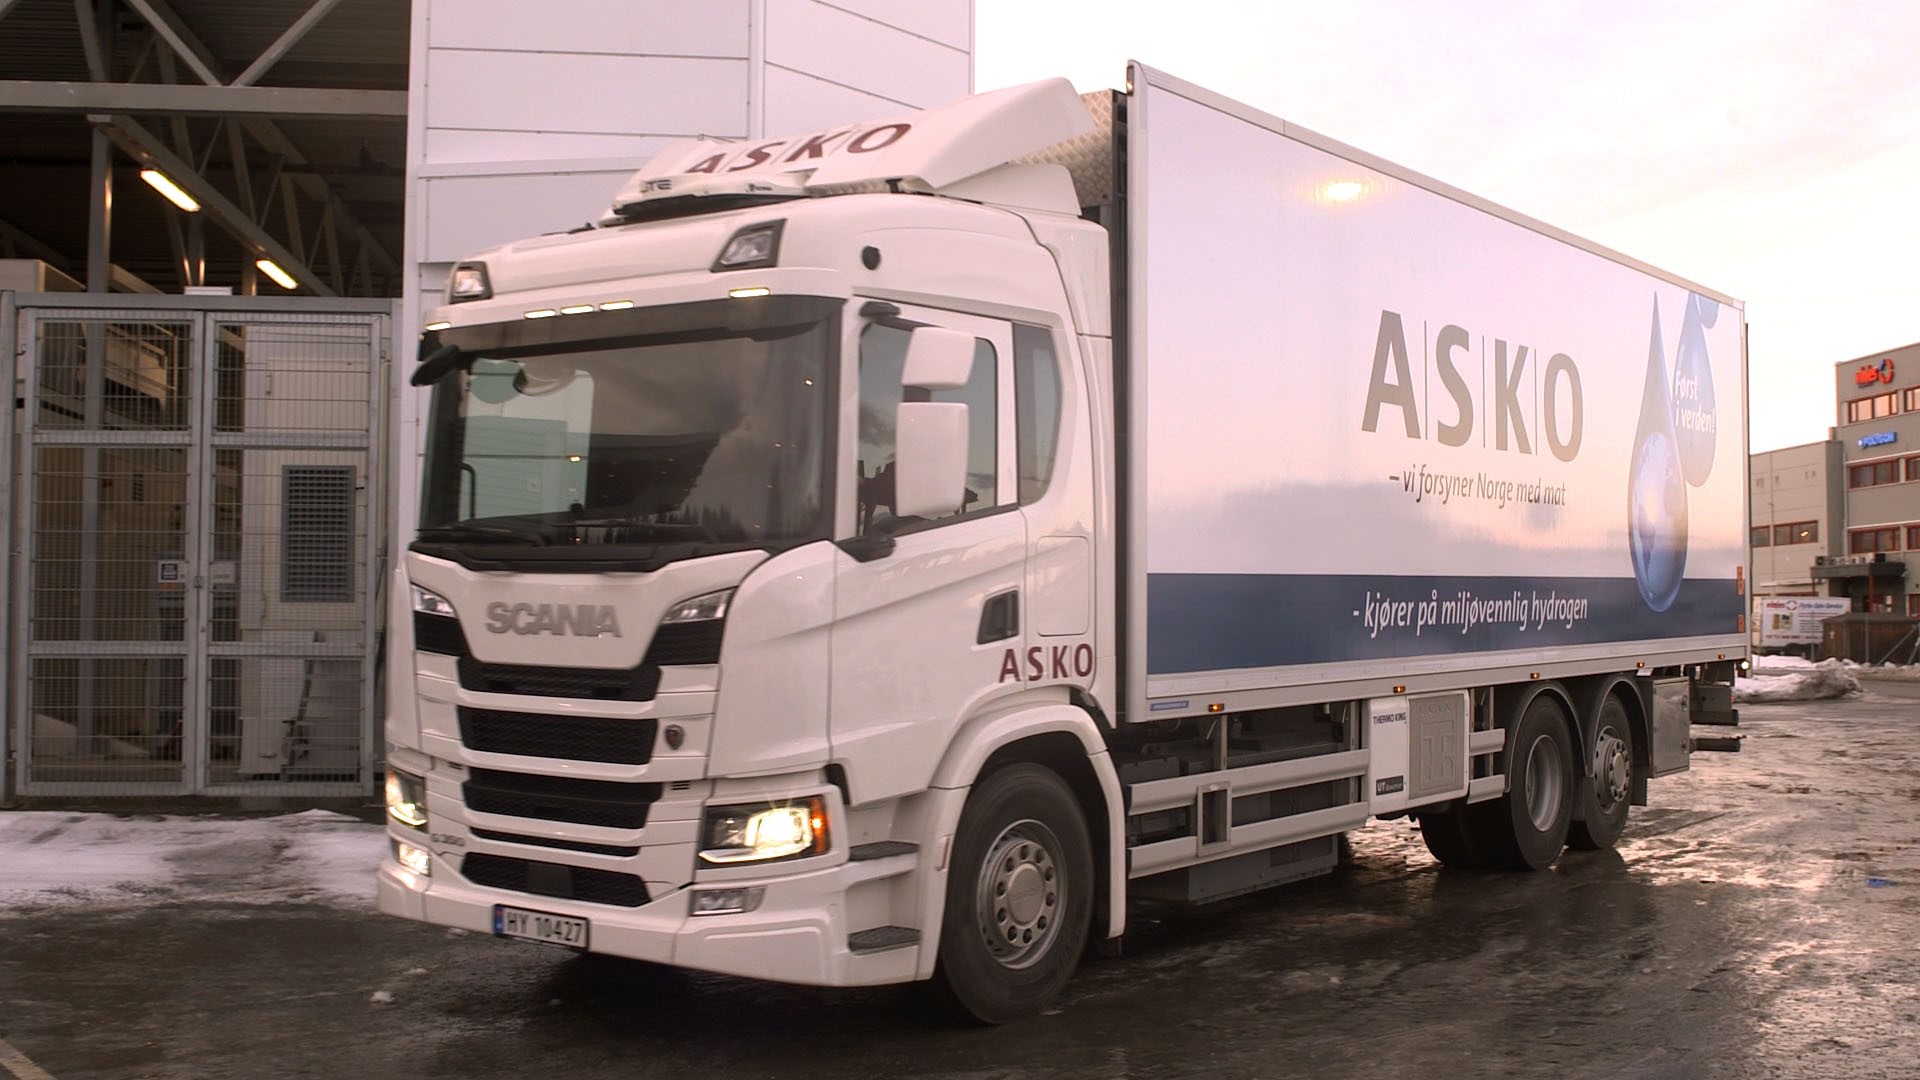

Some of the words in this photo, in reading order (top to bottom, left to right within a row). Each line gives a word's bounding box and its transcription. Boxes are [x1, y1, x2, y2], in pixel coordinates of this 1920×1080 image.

[684, 123, 912, 174] ASKO
[1361, 309, 1584, 462] ASKO
[1675, 370, 1698, 400] Først
[1676, 400, 1680, 427] i
[1681, 405, 1715, 434] verden!
[1416, 463, 1474, 505] forsyner
[1476, 472, 1513, 509] Norge
[1516, 478, 1541, 504] med
[1543, 482, 1566, 506] mat
[484, 601, 624, 638] SCANIA
[1364, 591, 1414, 638] kjører
[1416, 589, 1438, 636] på
[1441, 590, 1528, 634] miljøvennlig
[1531, 590, 1588, 631] hydrogen
[998, 643, 1093, 683] ASKO
[1373, 713, 1394, 725] THERMO
[1395, 712, 1406, 721] KING
[535, 917, 582, 943] 10427
